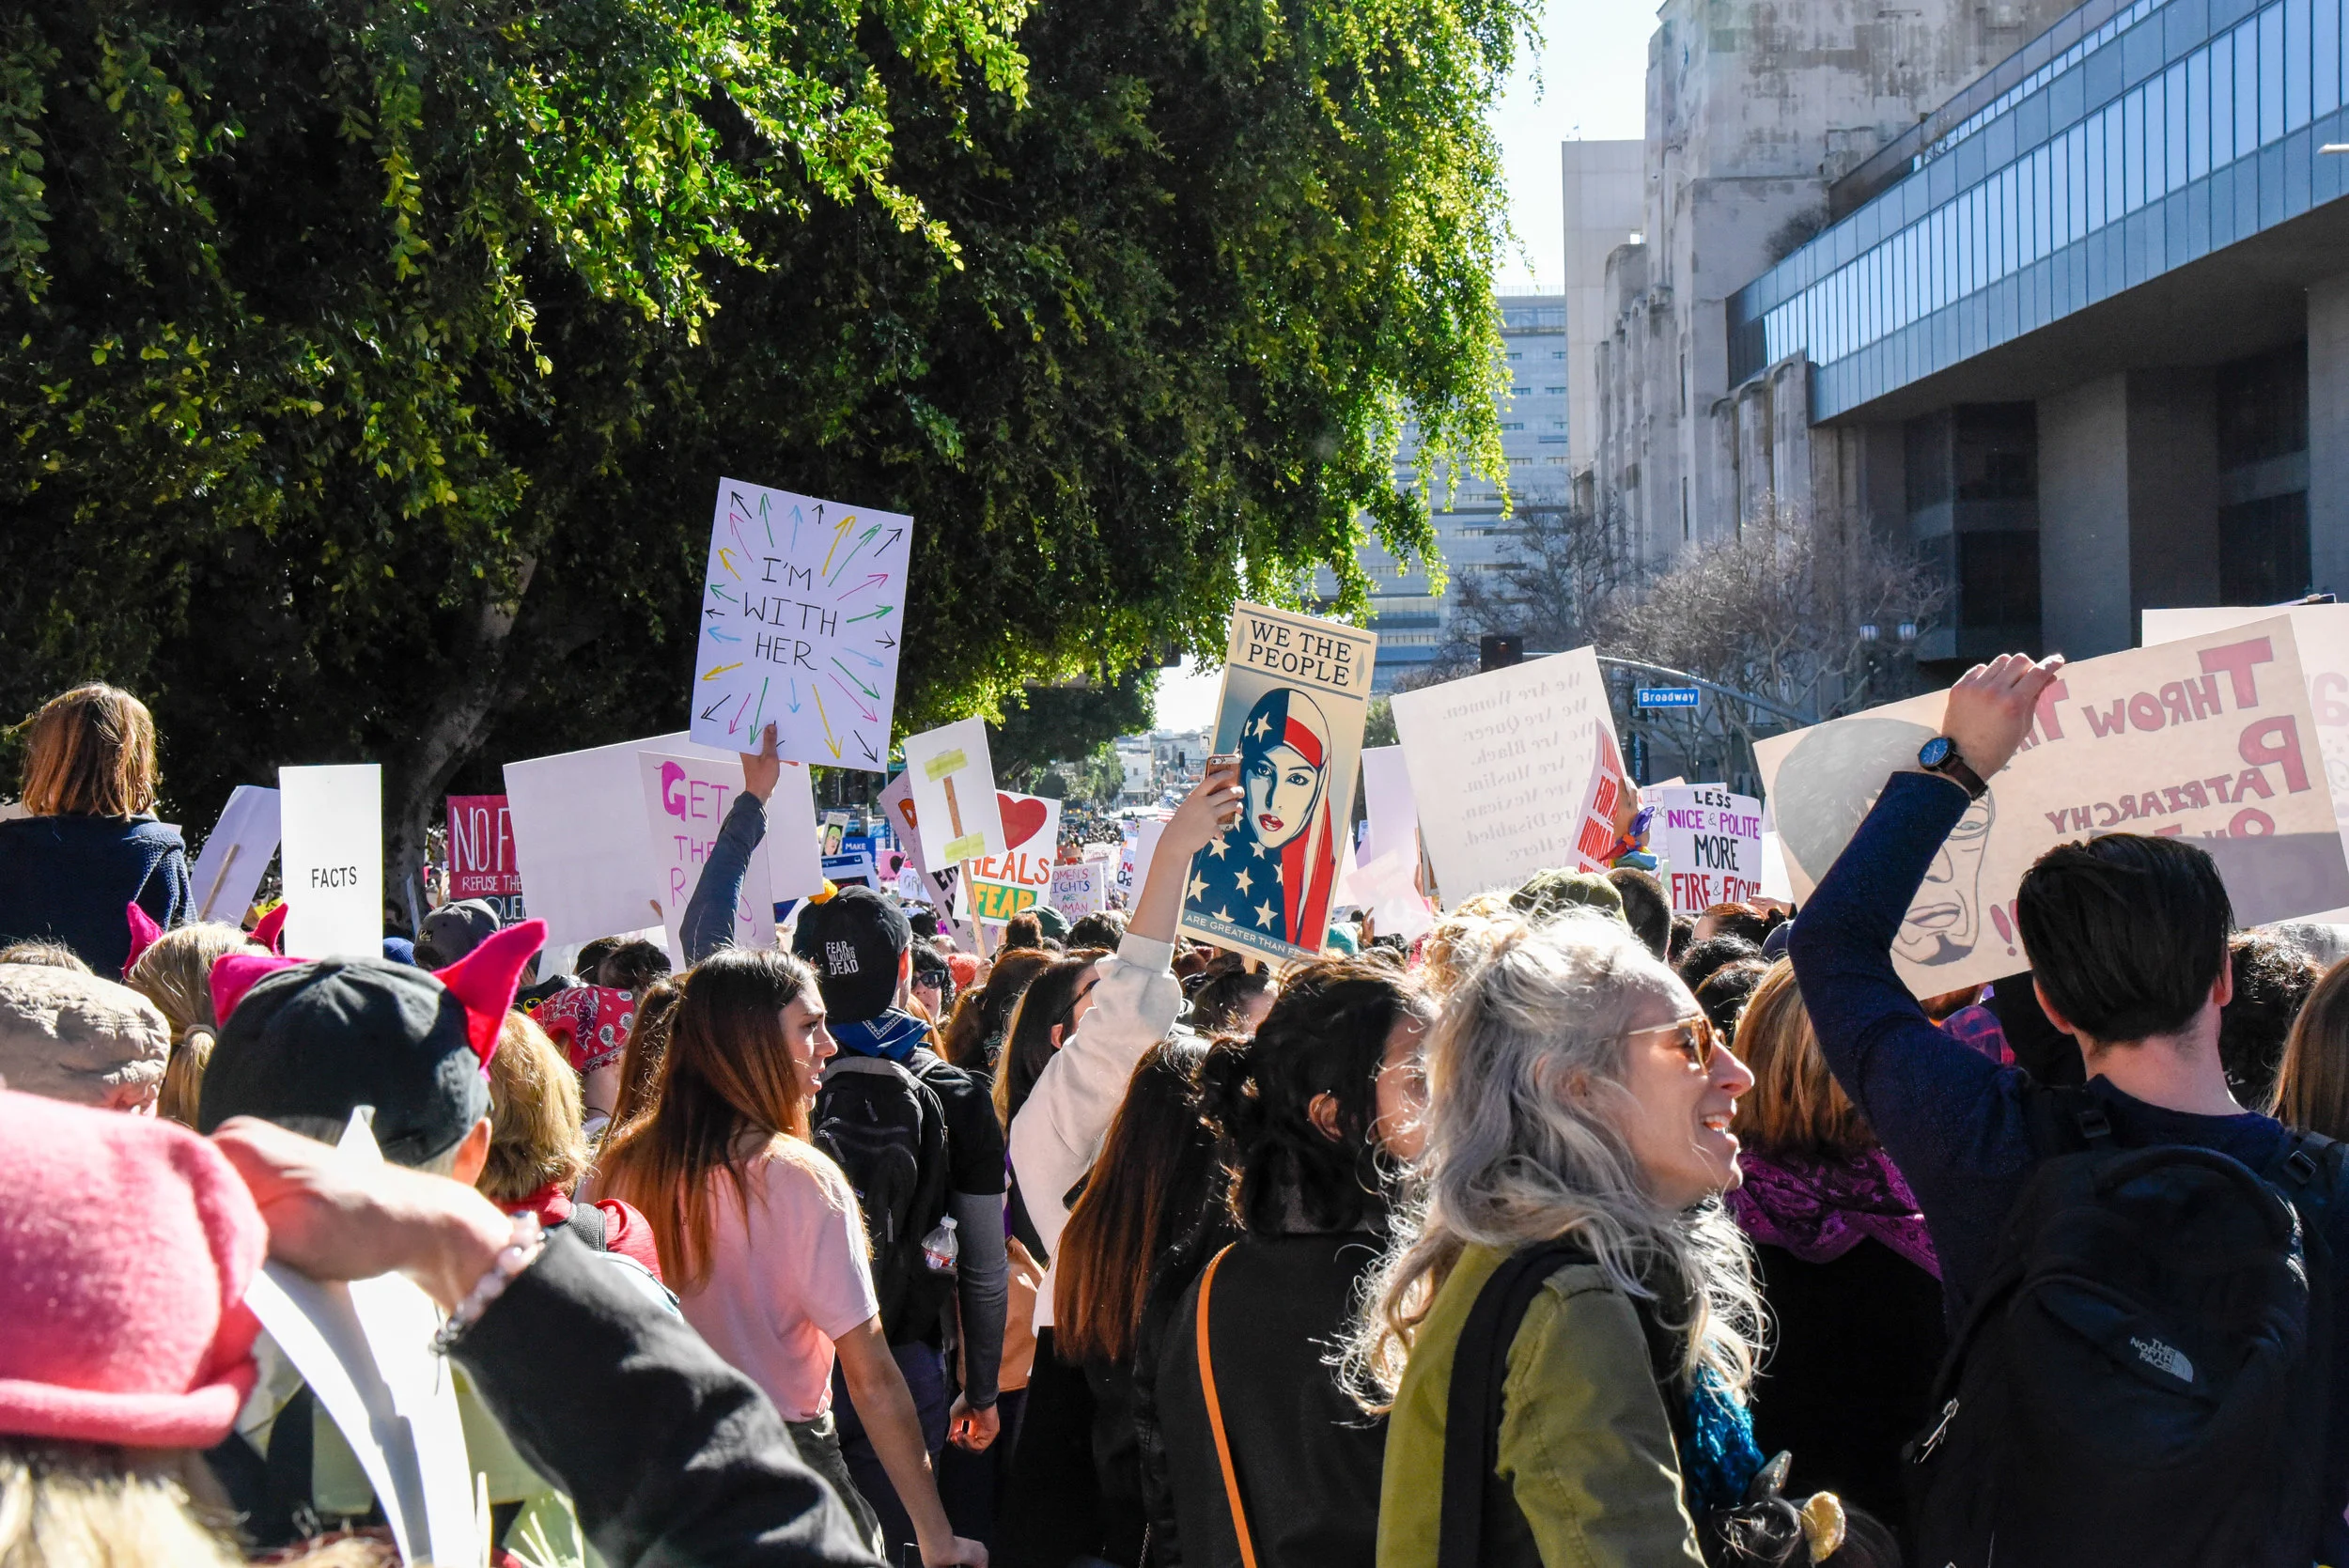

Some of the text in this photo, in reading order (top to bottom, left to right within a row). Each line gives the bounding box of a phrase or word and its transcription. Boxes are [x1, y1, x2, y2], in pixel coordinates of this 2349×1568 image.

[762, 557, 811, 591] I'M
[744, 592, 837, 637] WITH
[755, 632, 817, 670] HER
[1250, 620, 1352, 663] WE THE
[1247, 643, 1349, 687] PEOPLE
[1641, 692, 1695, 704] Broadway
[654, 760, 730, 822] GET
[1593, 774, 1616, 818] FOR
[1694, 790, 1732, 809] LESS
[1667, 809, 1705, 830] NICE
[1707, 812, 1717, 827] &
[1719, 812, 1761, 840] POLITE
[453, 805, 490, 873] NO
[845, 843, 867, 851] MAKE
[1693, 833, 1740, 872] MORE
[311, 865, 357, 889] FACTS
[462, 875, 498, 892] REFUSE
[1052, 868, 1089, 881] OMEN'S
[1052, 880, 1091, 893] IGHTS
[1671, 873, 1711, 911] FIRE
[1713, 880, 1721, 896] &
[1054, 902, 1088, 914] UMAN
[1186, 914, 1206, 927] ARE
[1209, 921, 1256, 942] GREATER
[1258, 936, 1286, 953] THAN
[826, 940, 849, 955] FEAR
[827, 951, 856, 963] WALKING
[829, 959, 859, 975] DEAD
[2130, 1337, 2173, 1362] NORTH
[2152, 1338, 2175, 1355] THE
[2139, 1351, 2172, 1372] FACE
